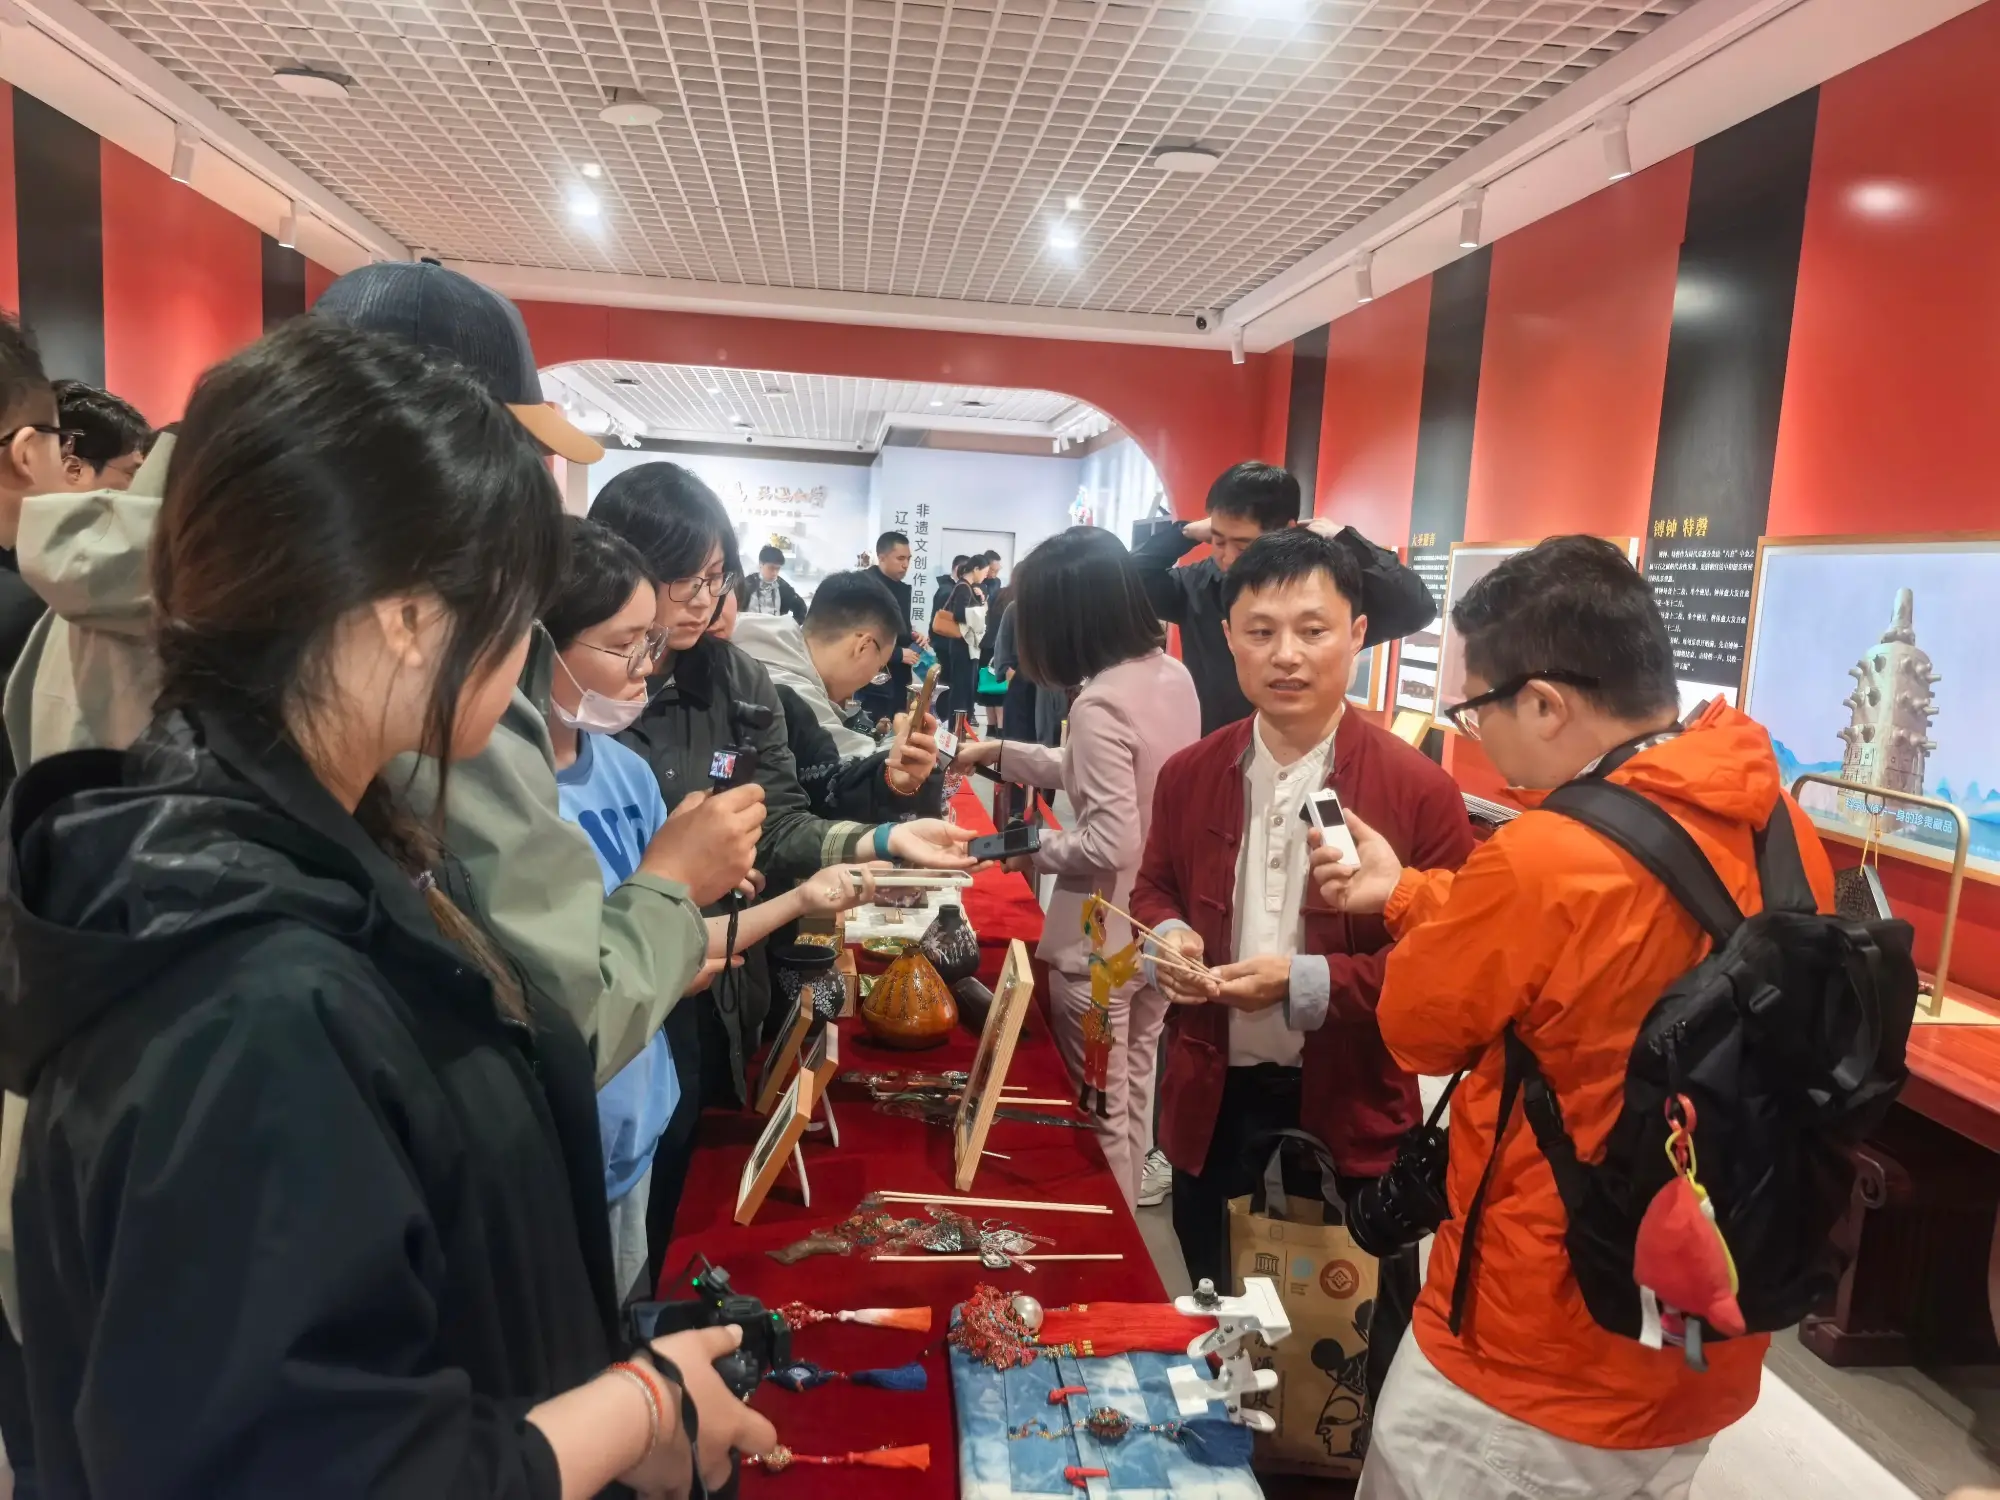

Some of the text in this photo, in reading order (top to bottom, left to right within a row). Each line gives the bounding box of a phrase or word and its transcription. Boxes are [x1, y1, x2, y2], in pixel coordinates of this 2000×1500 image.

[911, 503, 931, 622] 非遗文创作品展
